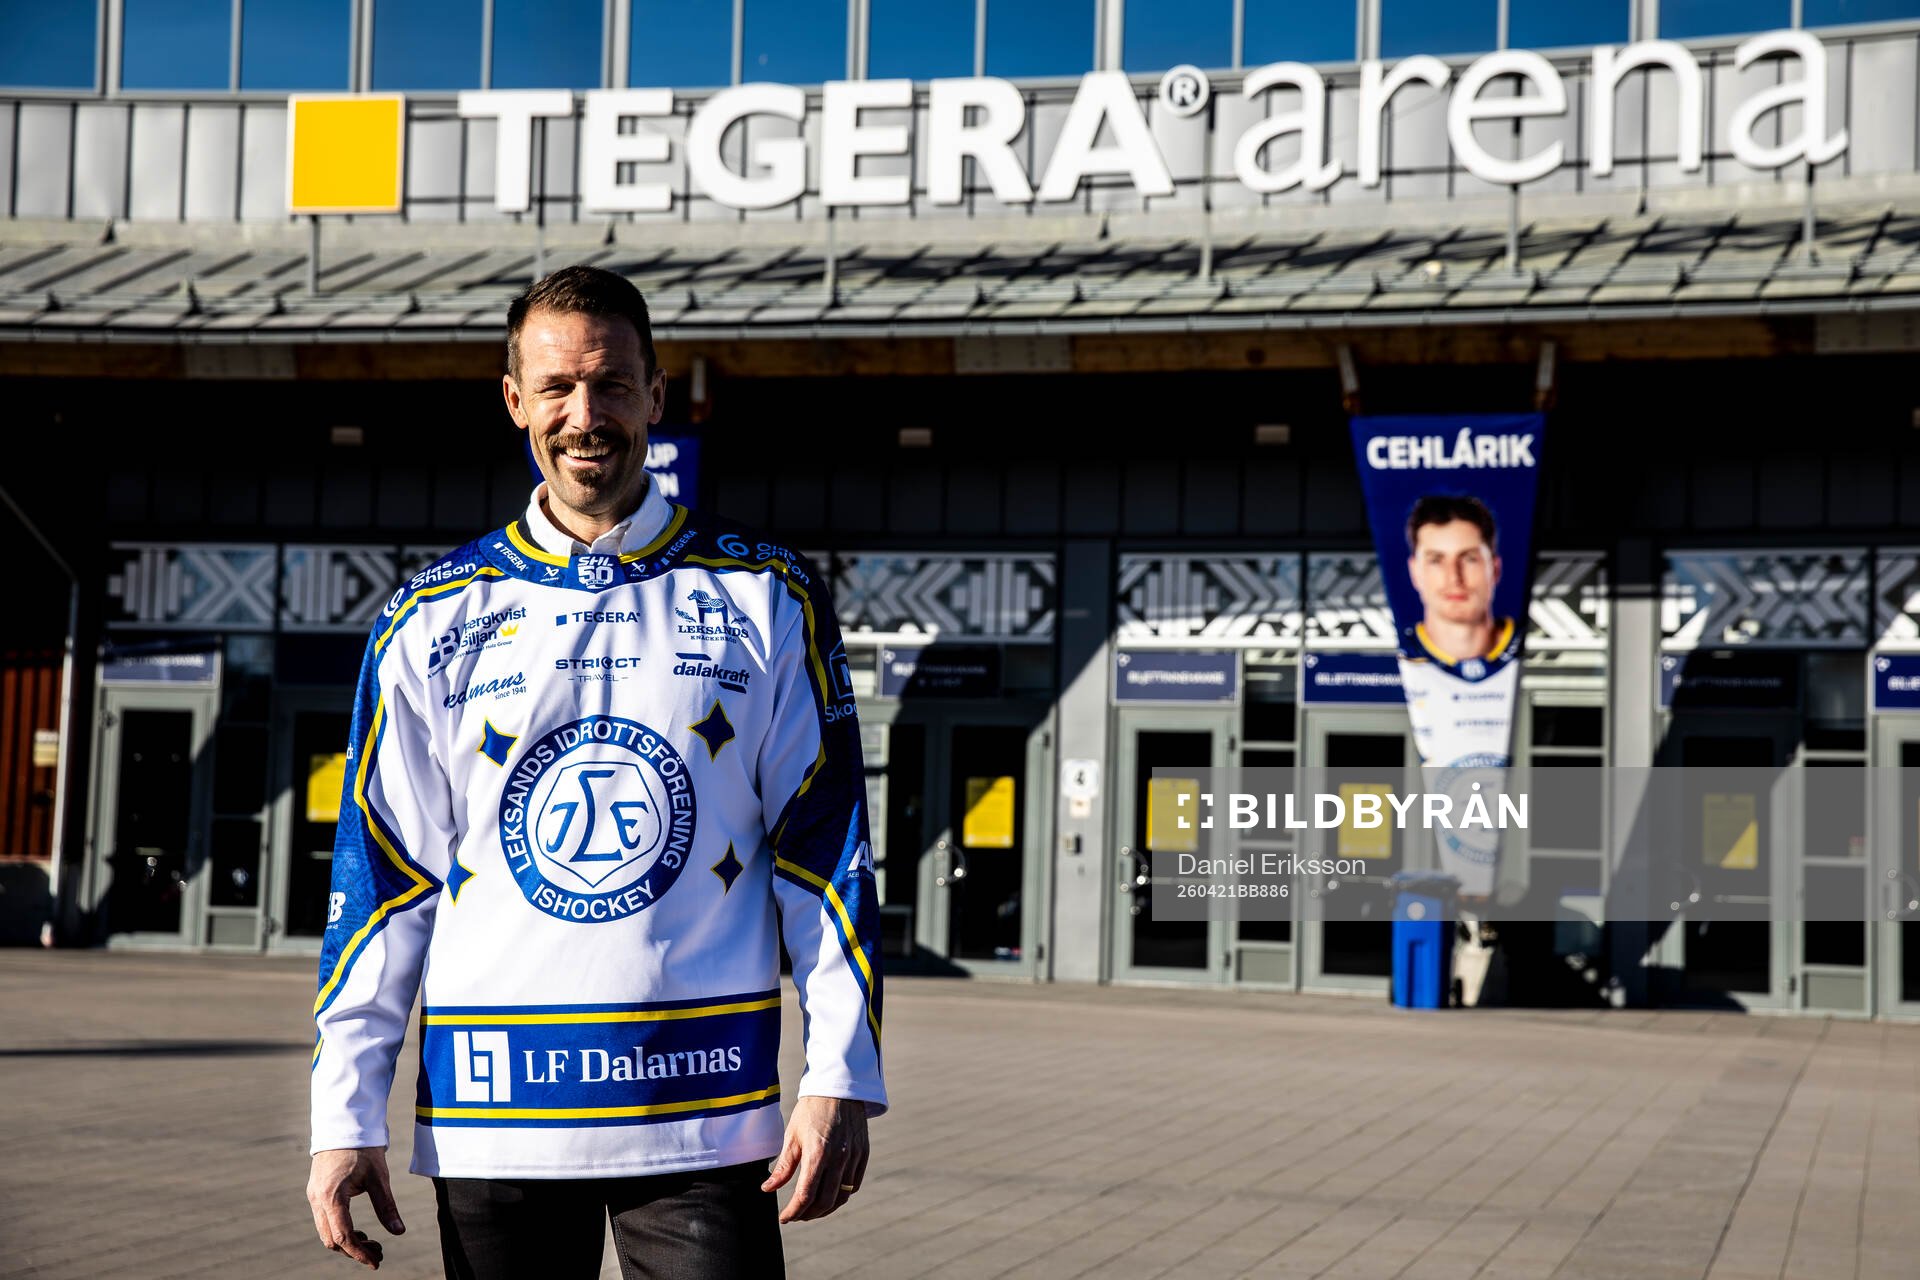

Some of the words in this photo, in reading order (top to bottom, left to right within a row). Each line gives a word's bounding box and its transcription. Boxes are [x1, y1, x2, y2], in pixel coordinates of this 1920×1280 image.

[1234, 28, 1849, 194] arena
[1366, 427, 1536, 469] CEHLÁRIK
[666, 530, 698, 557] TEGERA
[500, 546, 529, 572] TEGERA
[410, 563, 476, 589] Ohlson
[578, 566, 613, 586] 50
[678, 625, 749, 638] LEKSANDS
[577, 674, 619, 682] TRAVEL
[673, 662, 750, 685] dalakraft
[512, 686, 527, 696] 1941
[504, 744, 556, 873] LEKSANDS
[554, 720, 692, 870] IDROTTSFÖRENING
[531, 879, 655, 920] ISHOCKEY
[522, 1049, 570, 1083] LF
[579, 1046, 742, 1083] Dalarnas
